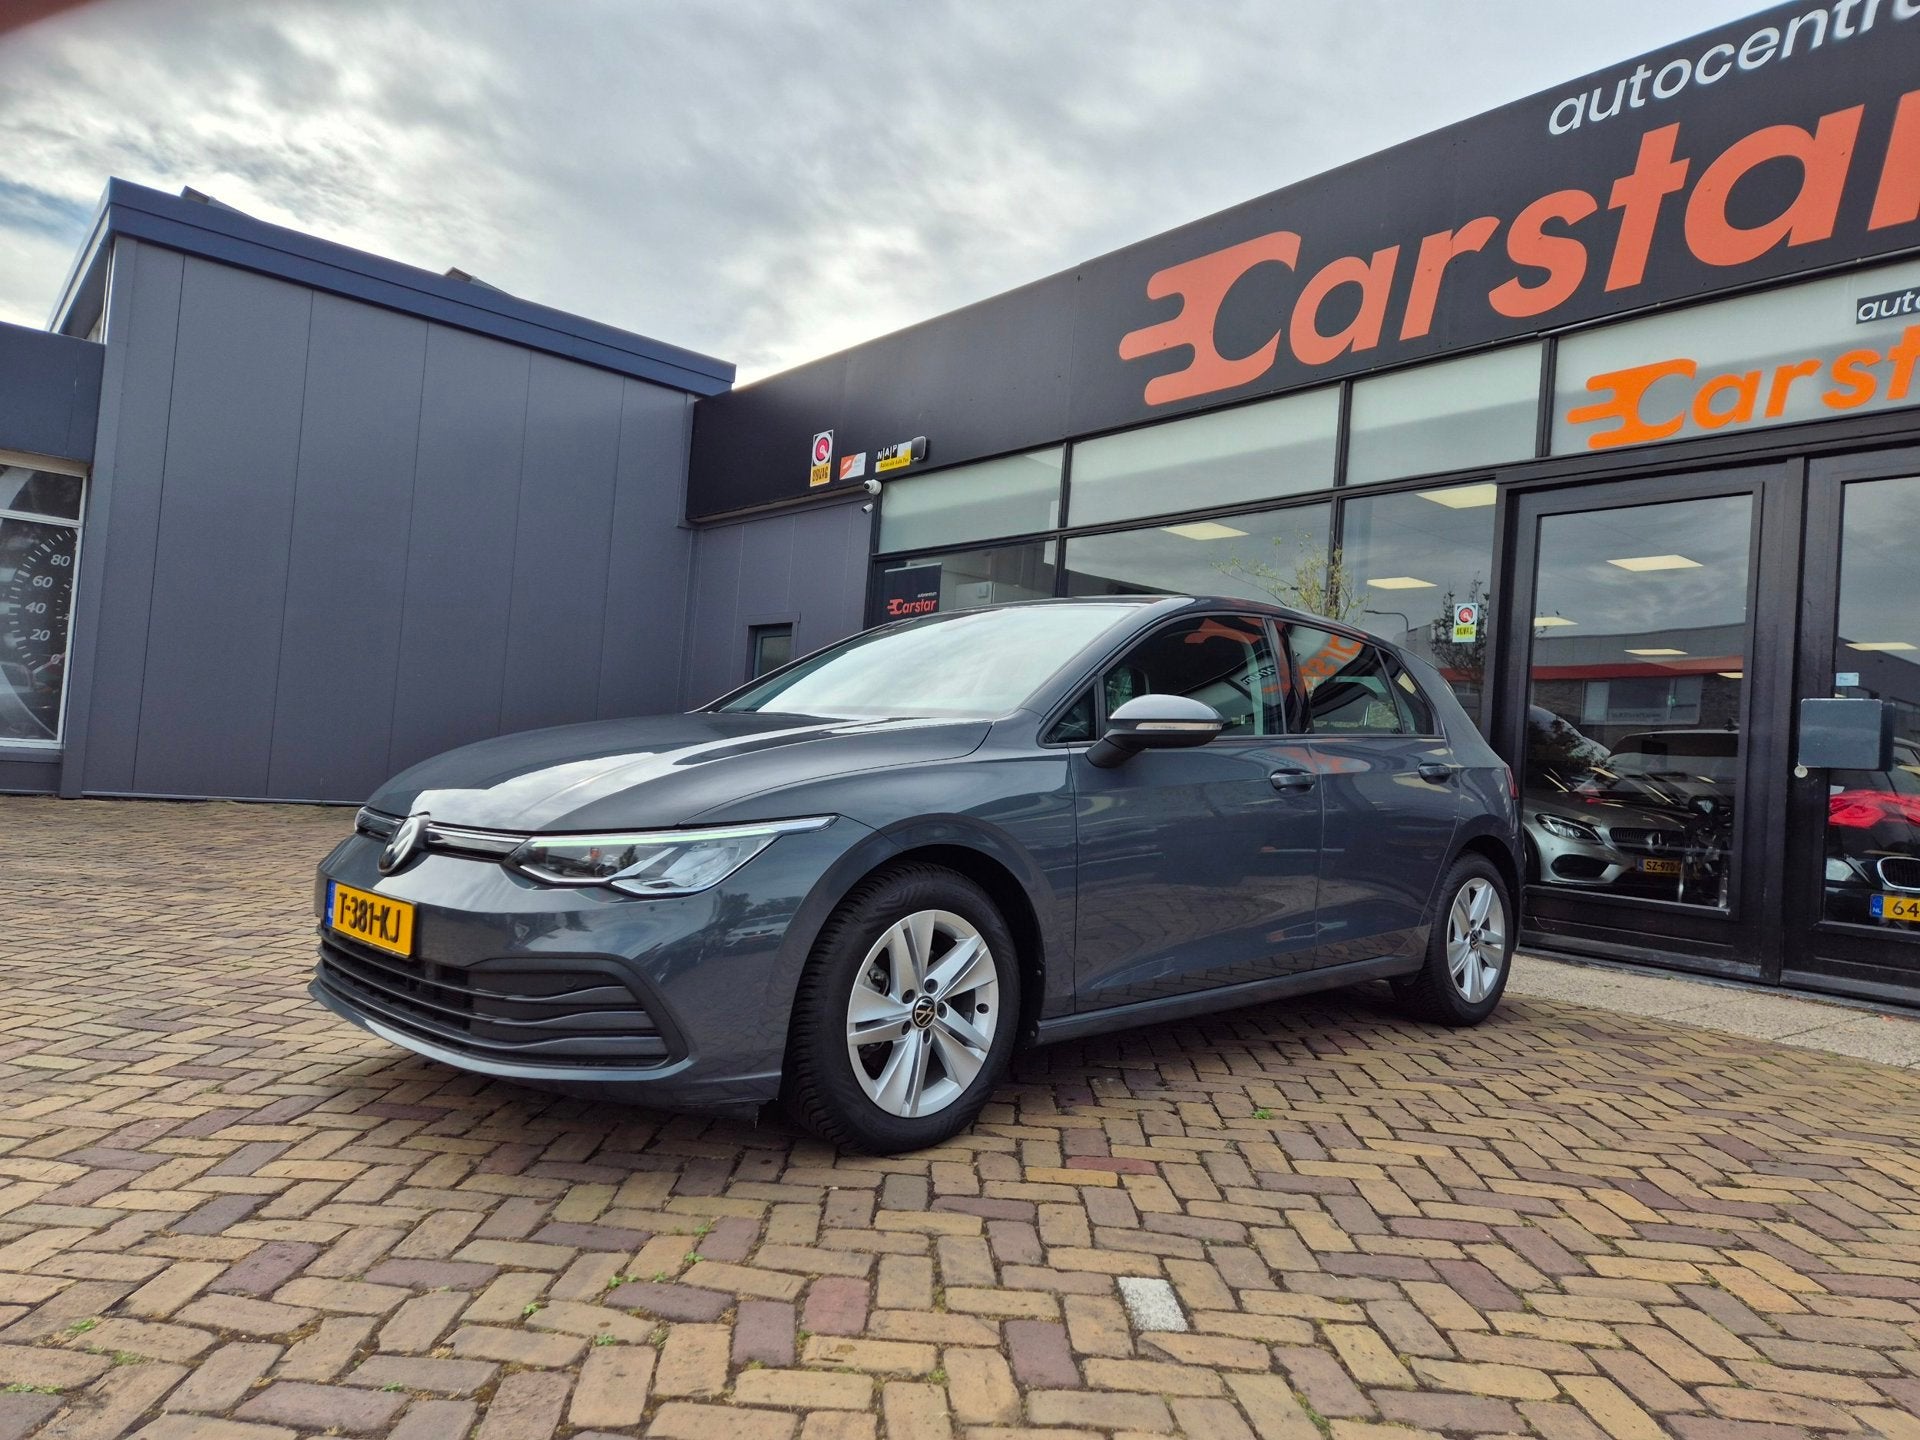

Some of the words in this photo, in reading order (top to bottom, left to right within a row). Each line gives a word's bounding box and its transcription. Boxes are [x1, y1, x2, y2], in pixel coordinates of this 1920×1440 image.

[50, 554, 71, 567] 80
[32, 575, 53, 588] 60
[25, 602, 47, 614] 40
[887, 598, 937, 615] Carstar
[30, 629, 51, 642] 20
[339, 892, 401, 944] T-381-KJ
